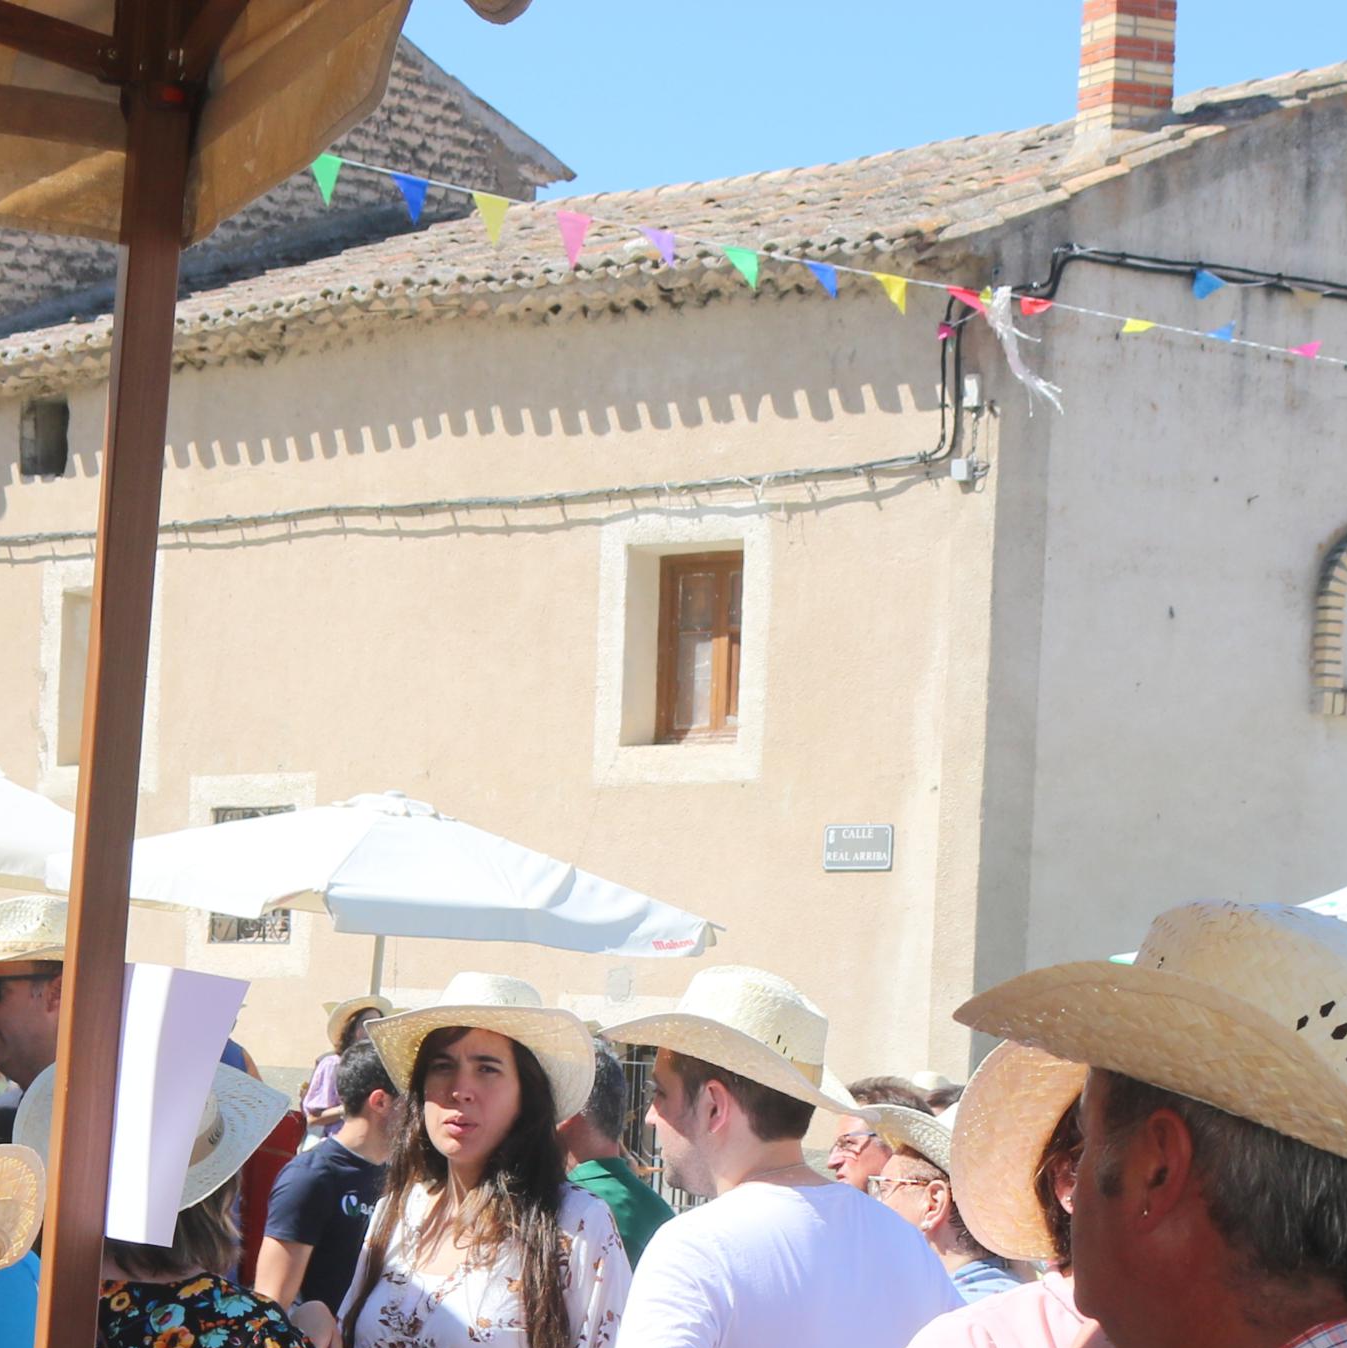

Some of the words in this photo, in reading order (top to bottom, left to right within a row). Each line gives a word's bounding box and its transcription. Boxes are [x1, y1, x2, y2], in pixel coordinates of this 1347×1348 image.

[842, 828, 875, 840] CALLE
[826, 851, 849, 862] REAL
[852, 851, 888, 862] ARRIBA
